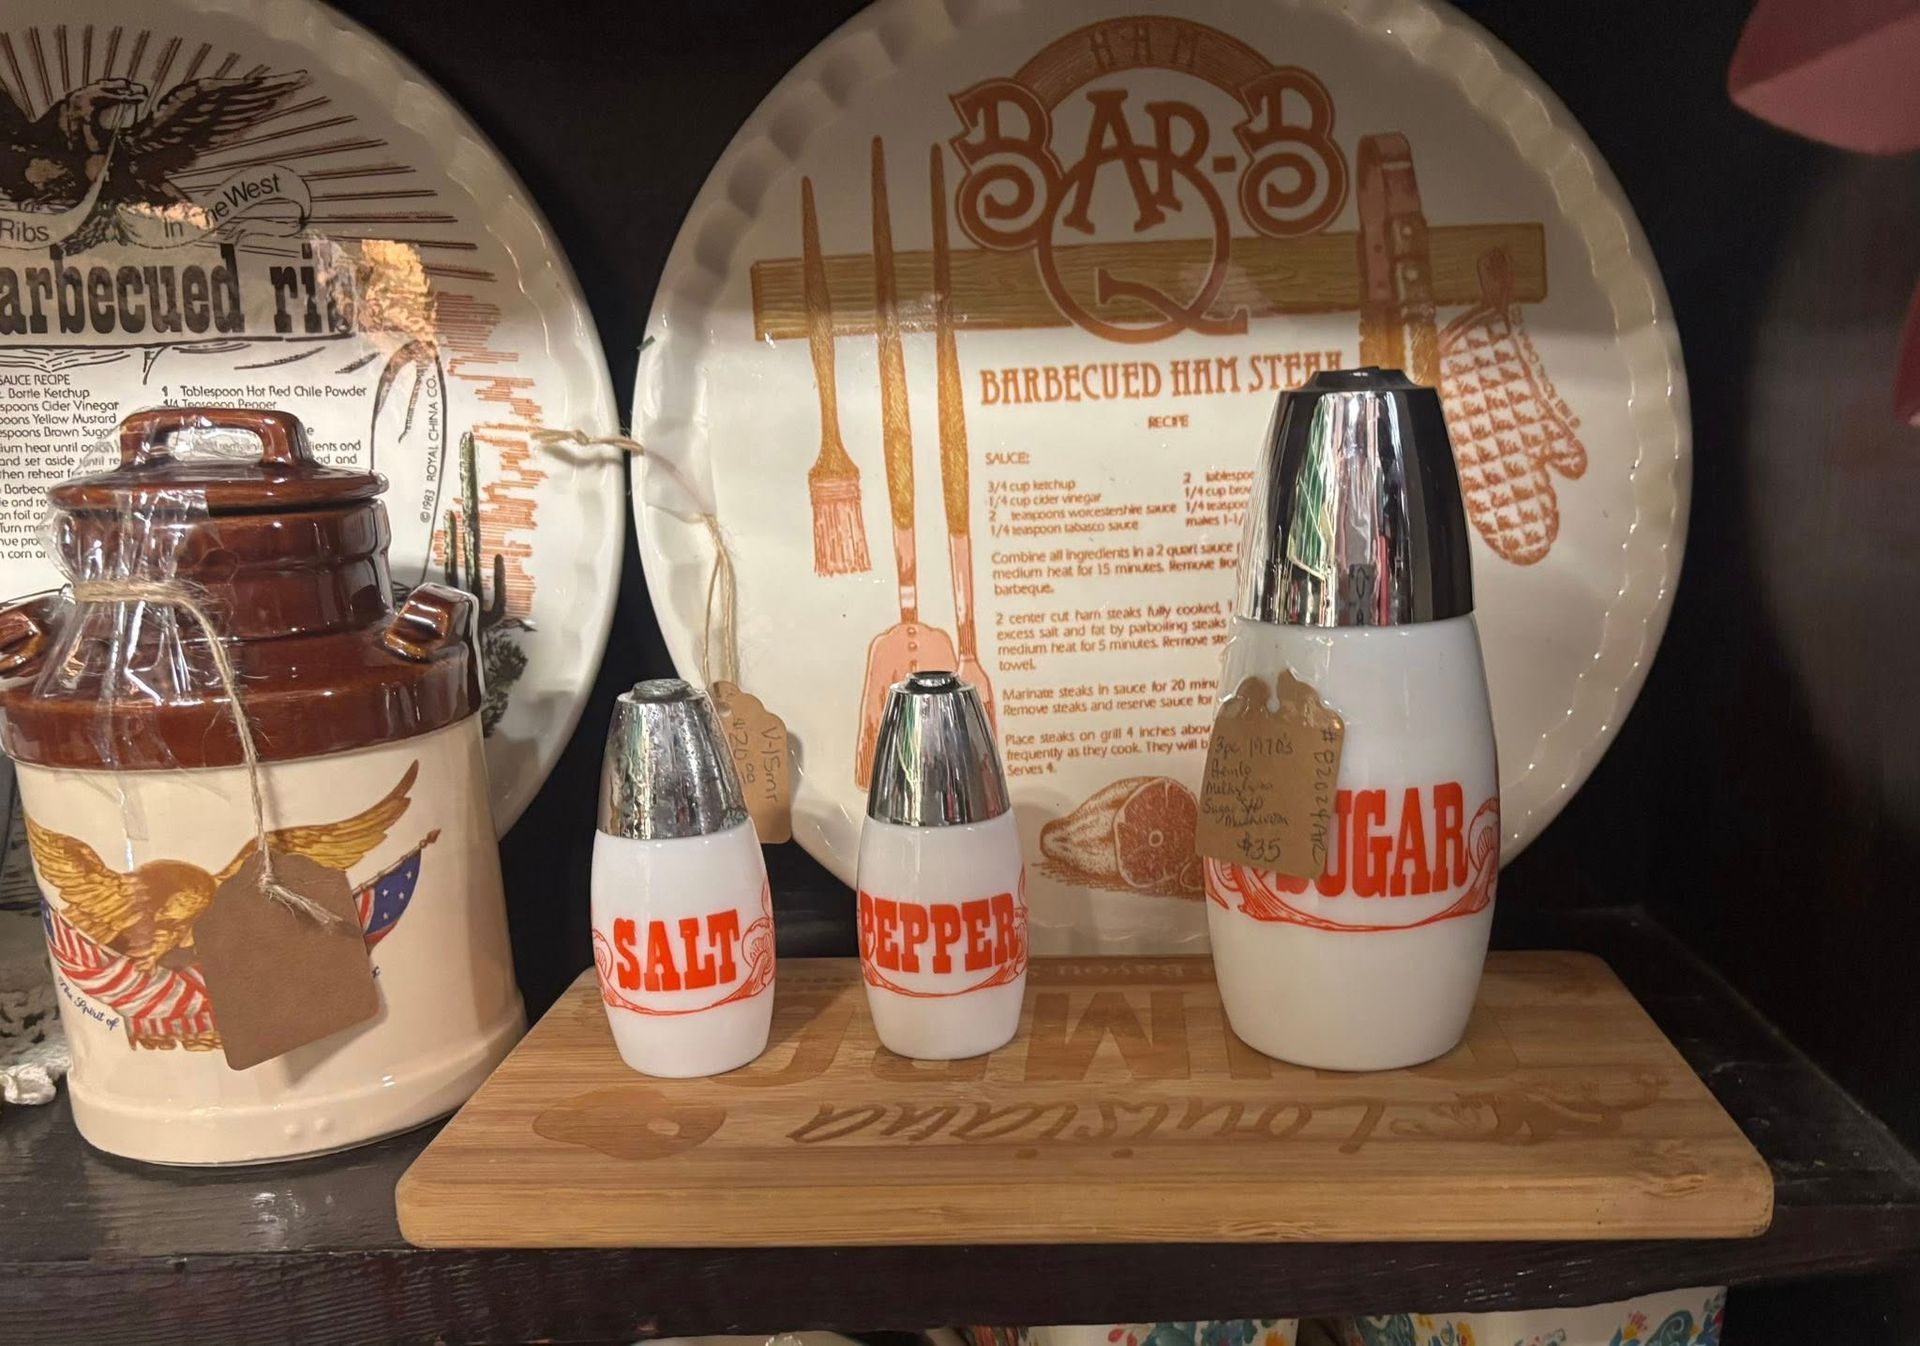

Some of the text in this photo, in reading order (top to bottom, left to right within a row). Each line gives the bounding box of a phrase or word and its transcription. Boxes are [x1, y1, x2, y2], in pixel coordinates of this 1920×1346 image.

[164, 173, 281, 238] In he West
[0, 218, 50, 242] Ribs
[0, 243, 245, 335] arbecued
[34, 374, 71, 386] RECIPE
[425, 374, 438, 398] CO.
[979, 361, 1162, 406] BARBECUED
[1170, 355, 1243, 396] HAM
[9, 387, 40, 399] Bottle
[44, 387, 90, 400] Ketchup
[180, 385, 244, 398] Tablespoon
[246, 385, 266, 396] Hot
[269, 386, 291, 396] Red
[294, 385, 323, 396] Chile
[325, 386, 367, 397] Powder
[0, 400, 120, 414] spoons Cider Vinegar
[32, 413, 117, 425] Yellow Mustard
[427, 401, 439, 442] CHINA
[1147, 414, 1190, 430] RECIPE
[44, 426, 112, 439] Brown Suga
[0, 442, 79, 453] ium heat until
[312, 440, 361, 452] ients and
[25, 457, 41, 467] set
[45, 456, 75, 467] aside
[336, 454, 358, 465] and
[426, 445, 439, 482] ROYAL
[985, 452, 1029, 465] SAUCE:
[28, 469, 64, 480] reheat
[4, 483, 50, 495] Barbecu
[1009, 482, 1031, 492] cup
[1033, 480, 1076, 490] ketchup
[1205, 487, 1226, 497] cup
[11, 496, 33, 508] and
[1010, 496, 1031, 507] cup
[1033, 495, 1058, 505] cider
[1062, 493, 1101, 504] vinegar
[14, 509, 31, 520] foil
[1011, 510, 1065, 521] teaspoons
[1068, 505, 1142, 518] worcestershire
[1146, 504, 1176, 514] sauce
[1185, 516, 1219, 526] makes
[1012, 525, 1062, 536] teaspoon
[1064, 523, 1105, 533] tabasco
[1108, 521, 1139, 531] sauce
[21, 537, 40, 549] pro
[8, 550, 33, 560] corn
[991, 551, 1046, 564] Combine
[1050, 549, 1063, 561] all
[1066, 548, 1130, 562] ingredients
[1166, 544, 1197, 557] quart
[1200, 543, 1233, 554] sauce
[992, 568, 1042, 580] medium
[1047, 566, 1073, 577] heat
[1077, 564, 1093, 576] for
[1115, 563, 1164, 574] minutes.
[994, 583, 1054, 596] barbeque.
[1009, 613, 1045, 624] center
[1050, 611, 1069, 623] cut
[1075, 610, 1101, 621] ham
[1107, 607, 1141, 620] steaks
[1176, 603, 1221, 616] cooked,
[997, 618, 1227, 640] excess salt and fat by parboiling steaks
[998, 644, 1047, 655] medium
[1051, 642, 1076, 653] heat
[1080, 641, 1096, 652] for
[1110, 639, 1159, 650] minutes.
[999, 659, 1036, 672] towel.
[1002, 689, 1054, 701] Marinate
[1059, 686, 1093, 698] steaks
[1113, 684, 1146, 695] sauce
[1152, 682, 1167, 692] for
[1172, 681, 1185, 691] 20
[1190, 680, 1218, 690] minu
[1053, 701, 1087, 714] steaks
[1091, 699, 1113, 712] and
[1117, 699, 1156, 709] reserve
[1161, 697, 1193, 707] sauce
[1198, 694, 1212, 705] for
[1005, 734, 1035, 746] Place
[1040, 731, 1075, 744] steaks
[1079, 731, 1095, 741] on
[1100, 729, 1121, 742] grill
[1139, 727, 1176, 737] inches
[1007, 748, 1063, 762] frequently
[1083, 746, 1107, 757] they
[1111, 744, 1141, 755] cook.
[1146, 742, 1173, 753] They
[1176, 741, 1197, 750] will
[1007, 764, 1043, 777] Serves
[1237, 831, 1281, 863] $35
[859, 890, 1021, 974] PEPPER
[612, 908, 740, 992] SALT
[74, 996, 106, 1022] Spirit
[106, 1016, 120, 1031] of
[784, 1096, 1386, 1160] Louisiana
